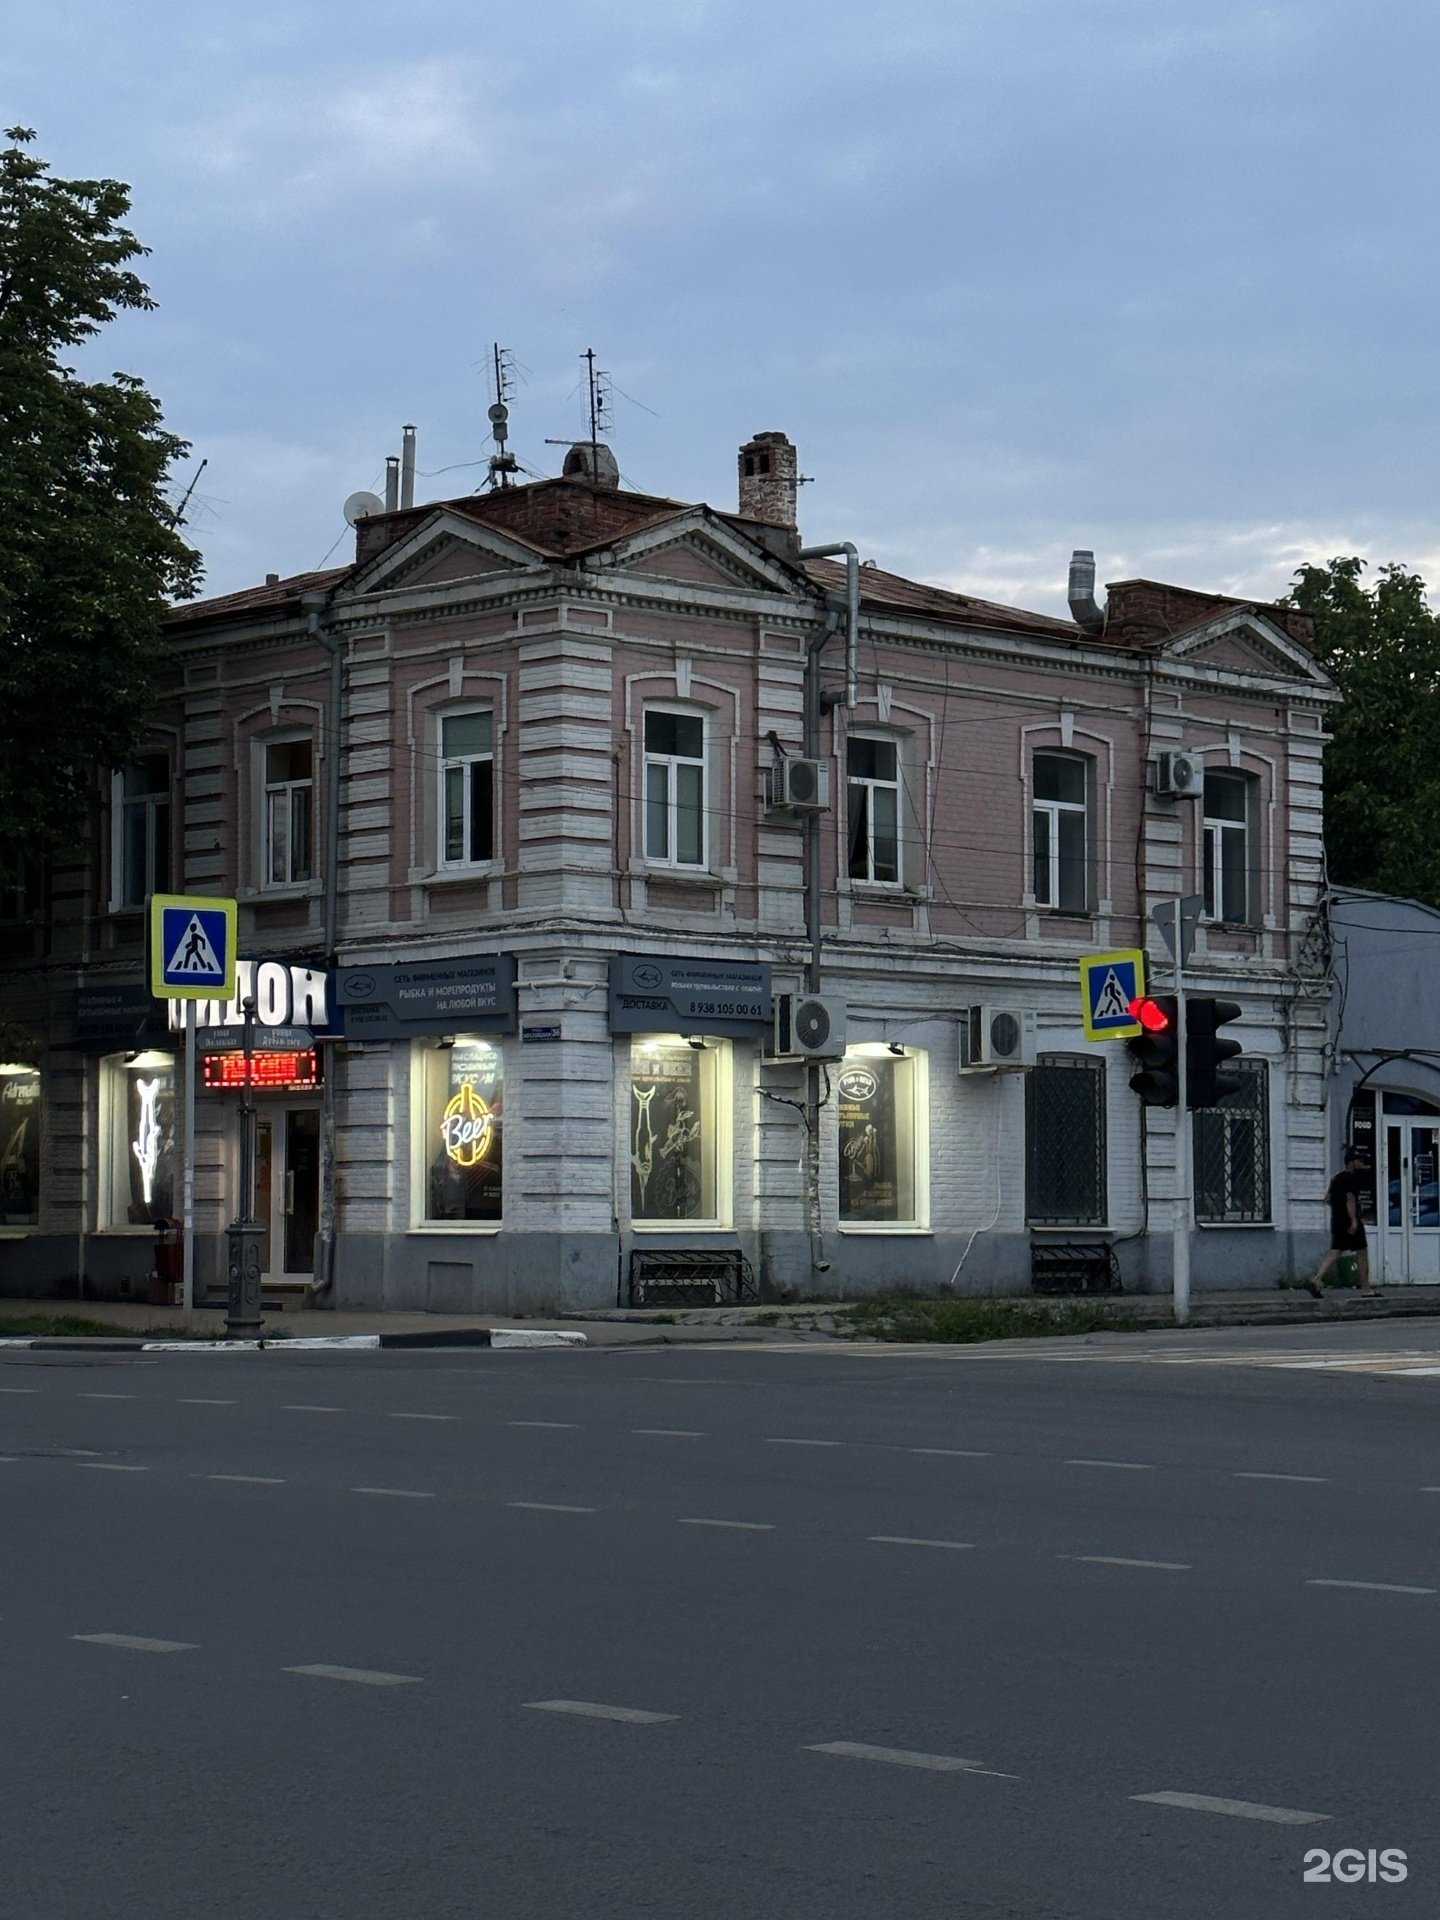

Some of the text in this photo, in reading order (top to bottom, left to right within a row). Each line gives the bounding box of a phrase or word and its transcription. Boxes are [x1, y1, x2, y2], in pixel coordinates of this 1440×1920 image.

[449, 997, 476, 1009] ЛЮБОЙ
[477, 996, 496, 1007] ВКУС
[623, 999, 668, 1010] ДОСТАВКА
[690, 1001, 762, 1016] 8 938 105 00 61
[440, 1114, 494, 1150] Beer
